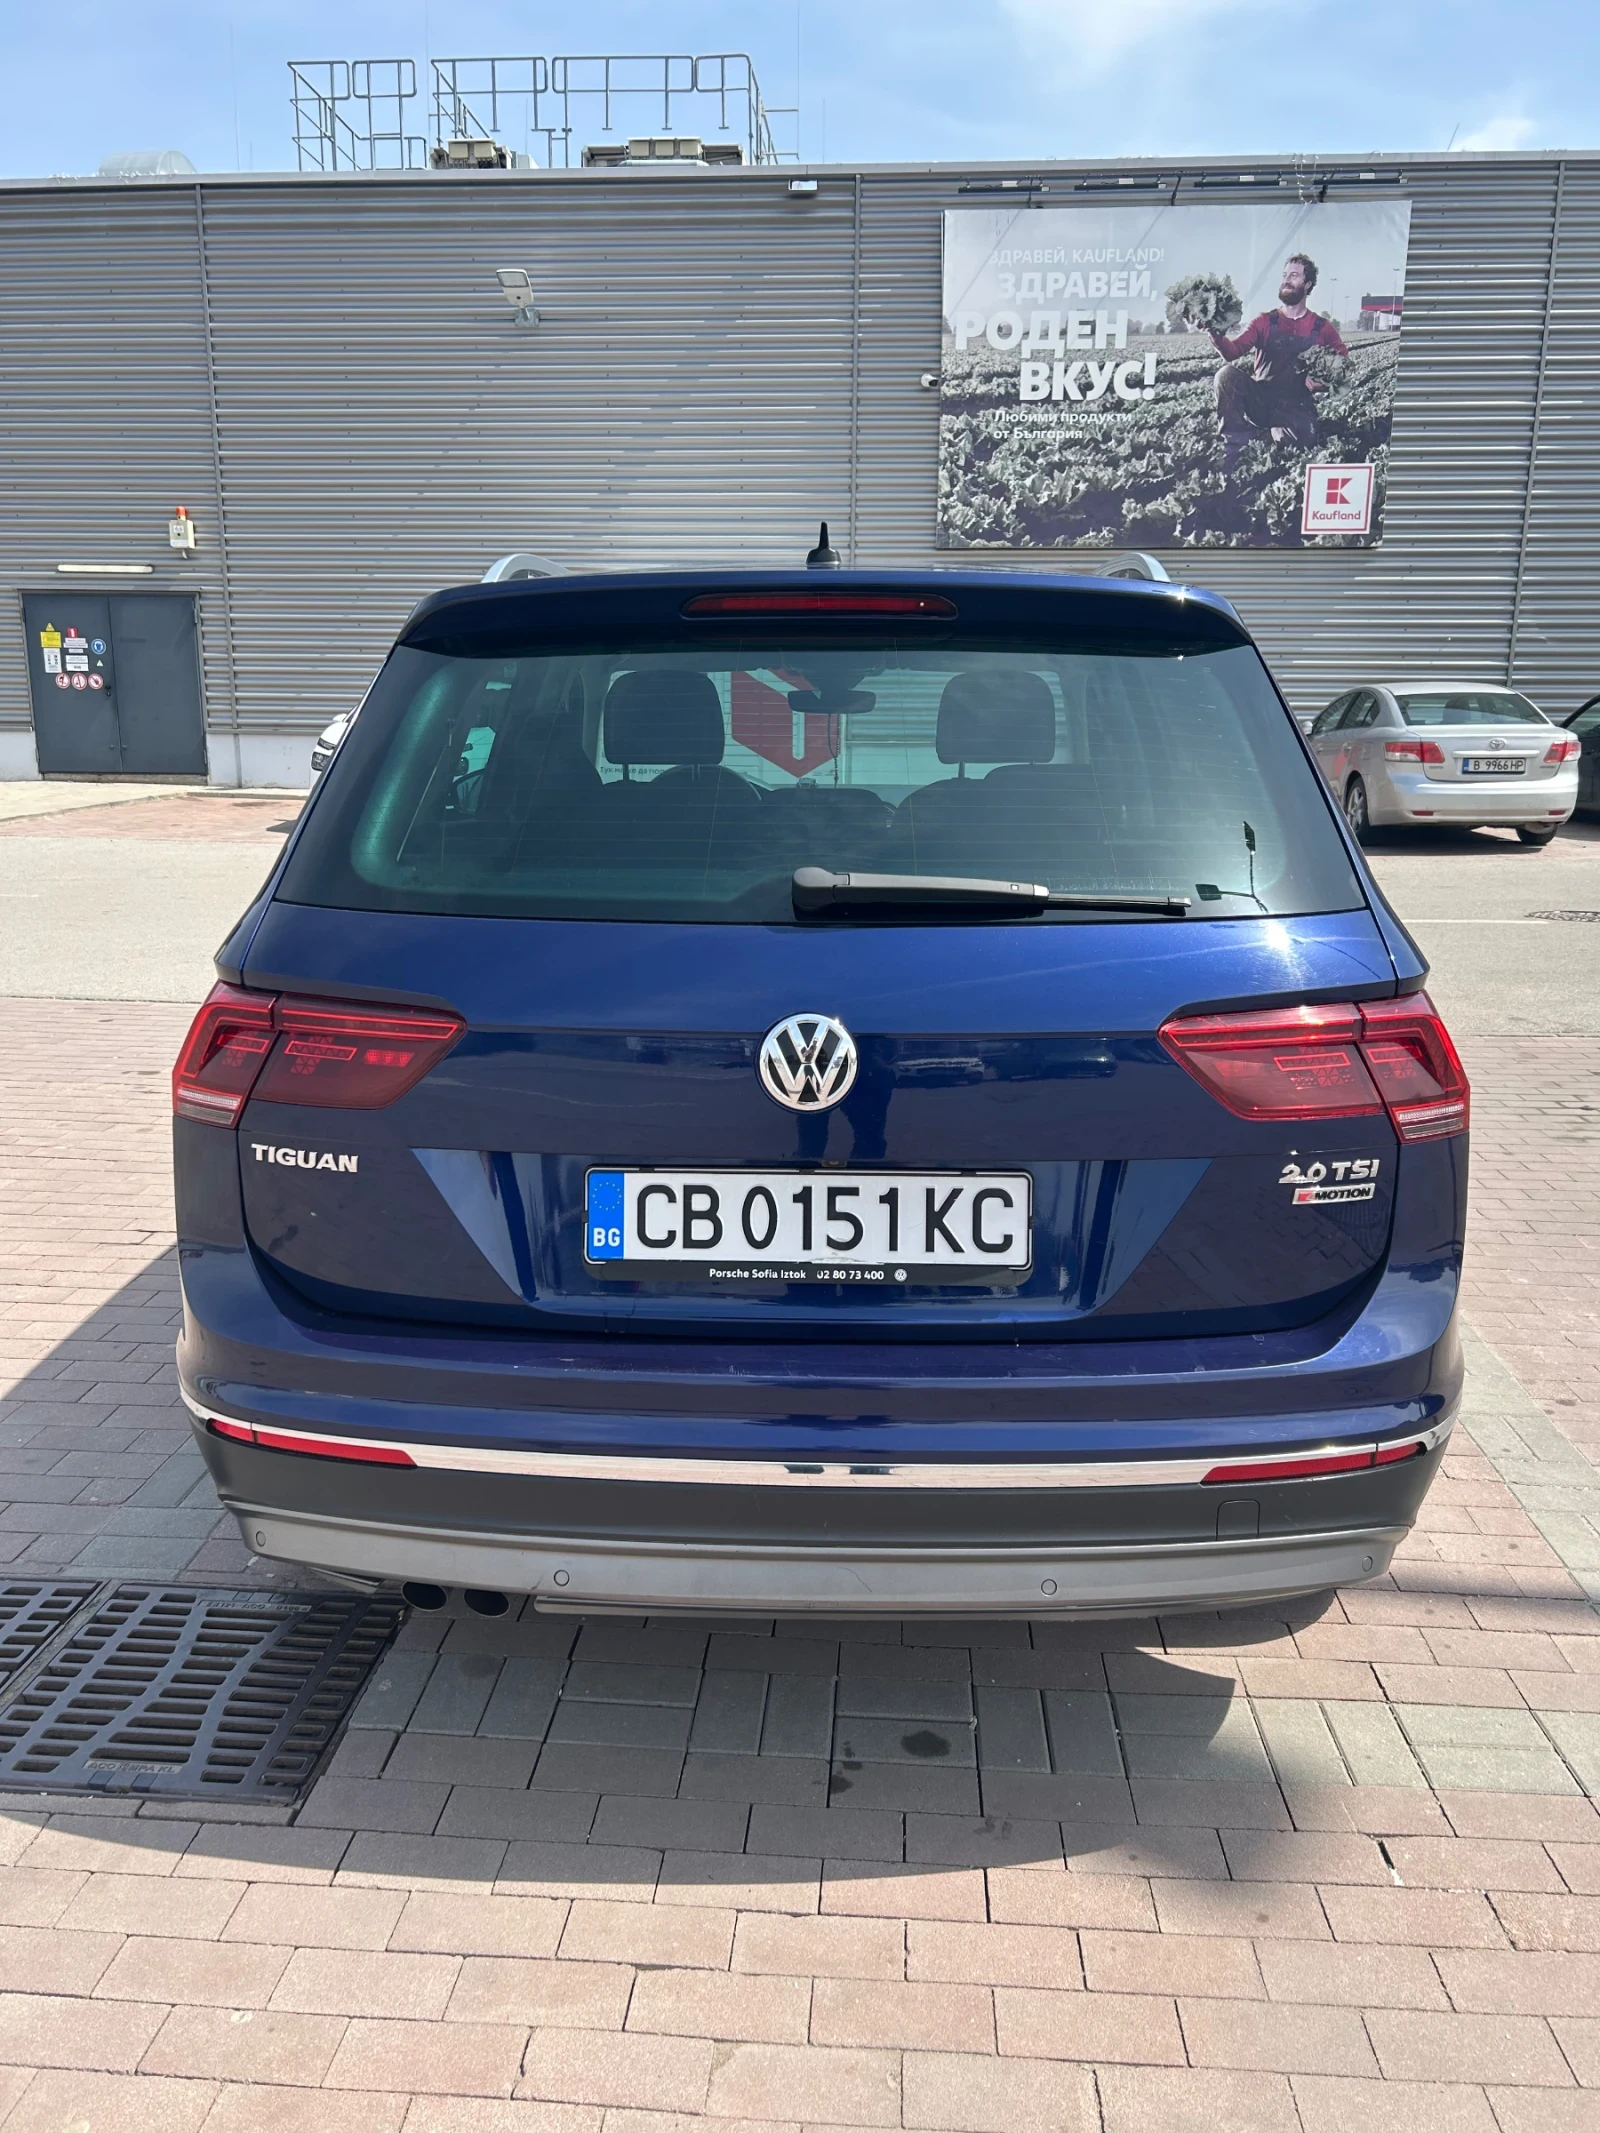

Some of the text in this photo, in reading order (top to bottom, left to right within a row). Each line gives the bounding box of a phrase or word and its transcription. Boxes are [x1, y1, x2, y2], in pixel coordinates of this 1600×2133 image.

[988, 247, 1165, 267] ЗДРАВЕЙ, KAUFLAND!
[997, 263, 1158, 305] ЗДРАВЕЙ,
[954, 309, 1129, 358] РОДЕН
[1019, 352, 1158, 401] ВКУС!
[993, 410, 1132, 425] Любими продукти
[993, 427, 1083, 441] от България
[1312, 510, 1361, 520] Kaufland
[1473, 760, 1524, 770] B 9966 HP
[250, 1143, 359, 1173] TIGUAN
[1331, 1159, 1380, 1181] TSI
[635, 1184, 1014, 1254] CB 0151 KC
[593, 1227, 621, 1247] BG
[709, 1268, 750, 1278] Porsche
[752, 1268, 778, 1279] Sofia
[780, 1269, 806, 1279] Iztok
[816, 1270, 830, 1280] 02
[833, 1270, 846, 1280] 80
[849, 1270, 862, 1280] 73
[864, 1270, 885, 1280] 400
[87, 1762, 116, 1770] ACO
